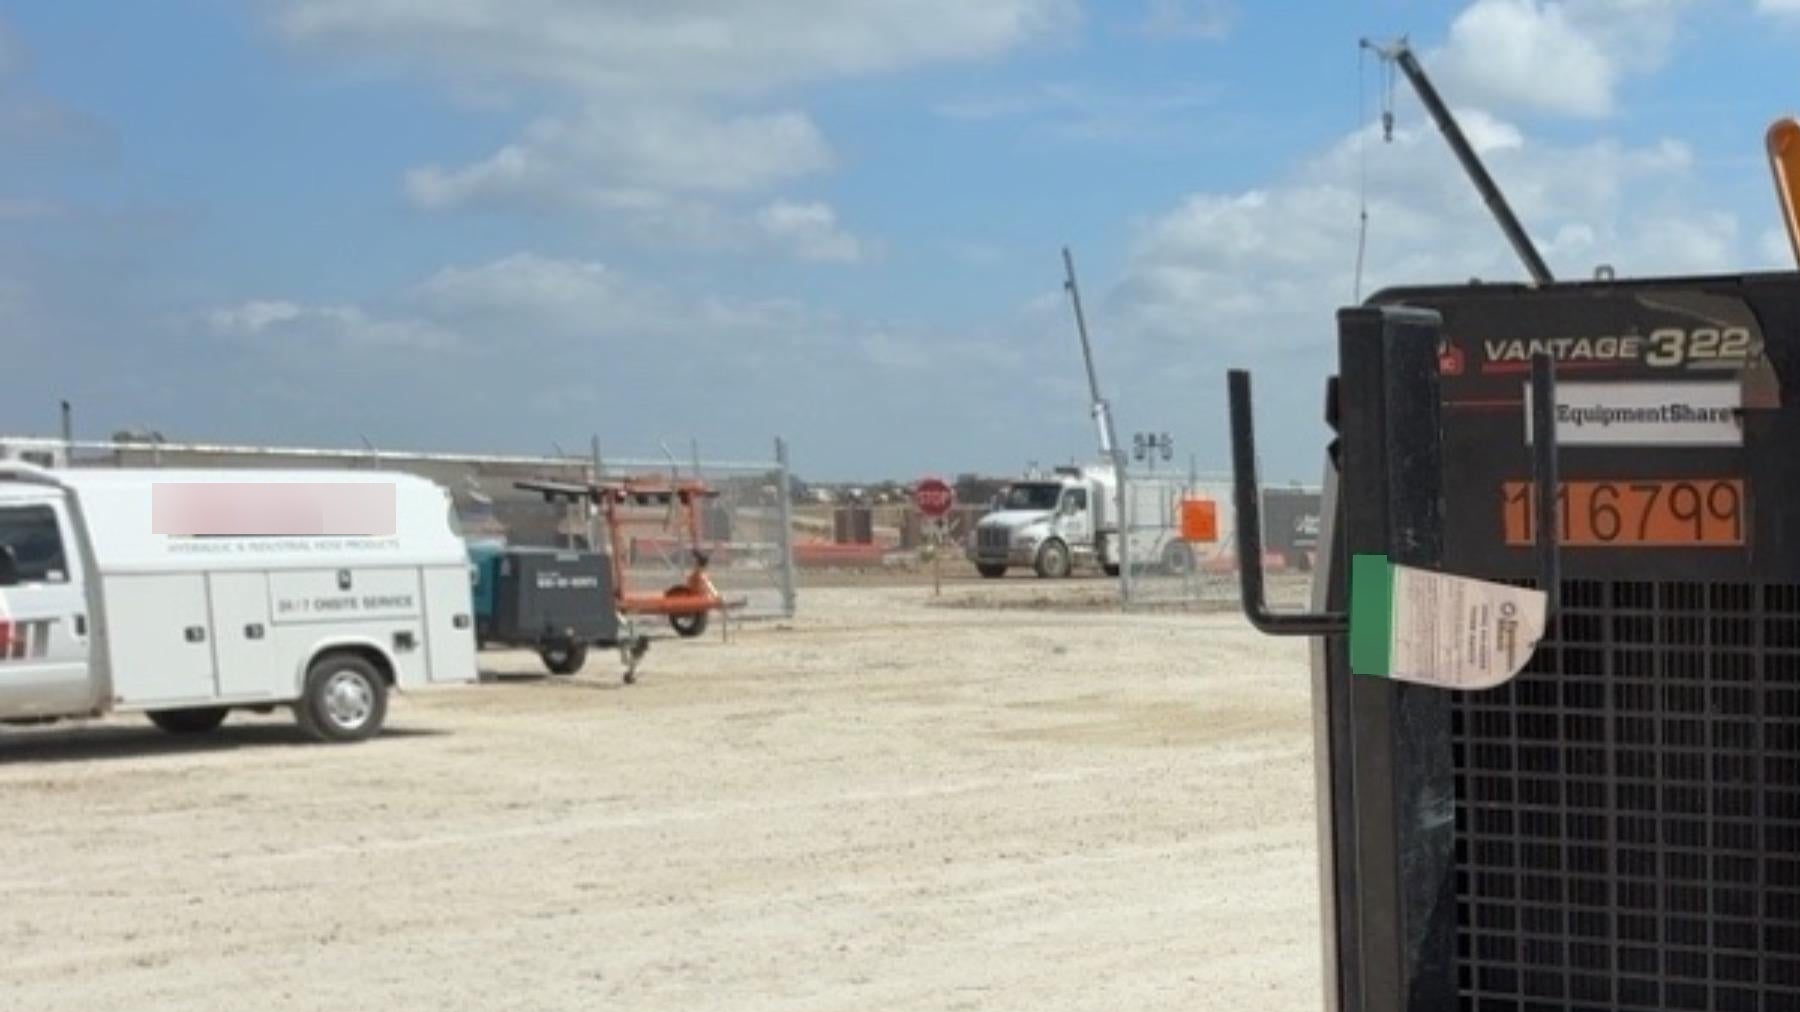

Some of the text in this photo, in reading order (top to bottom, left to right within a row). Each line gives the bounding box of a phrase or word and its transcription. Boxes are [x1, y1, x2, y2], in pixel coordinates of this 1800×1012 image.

[1483, 336, 1641, 362] VANTAGE
[1646, 328, 1750, 367] 322
[1556, 403, 1734, 427] EquipmentShare
[1510, 481, 1742, 543] 116799
